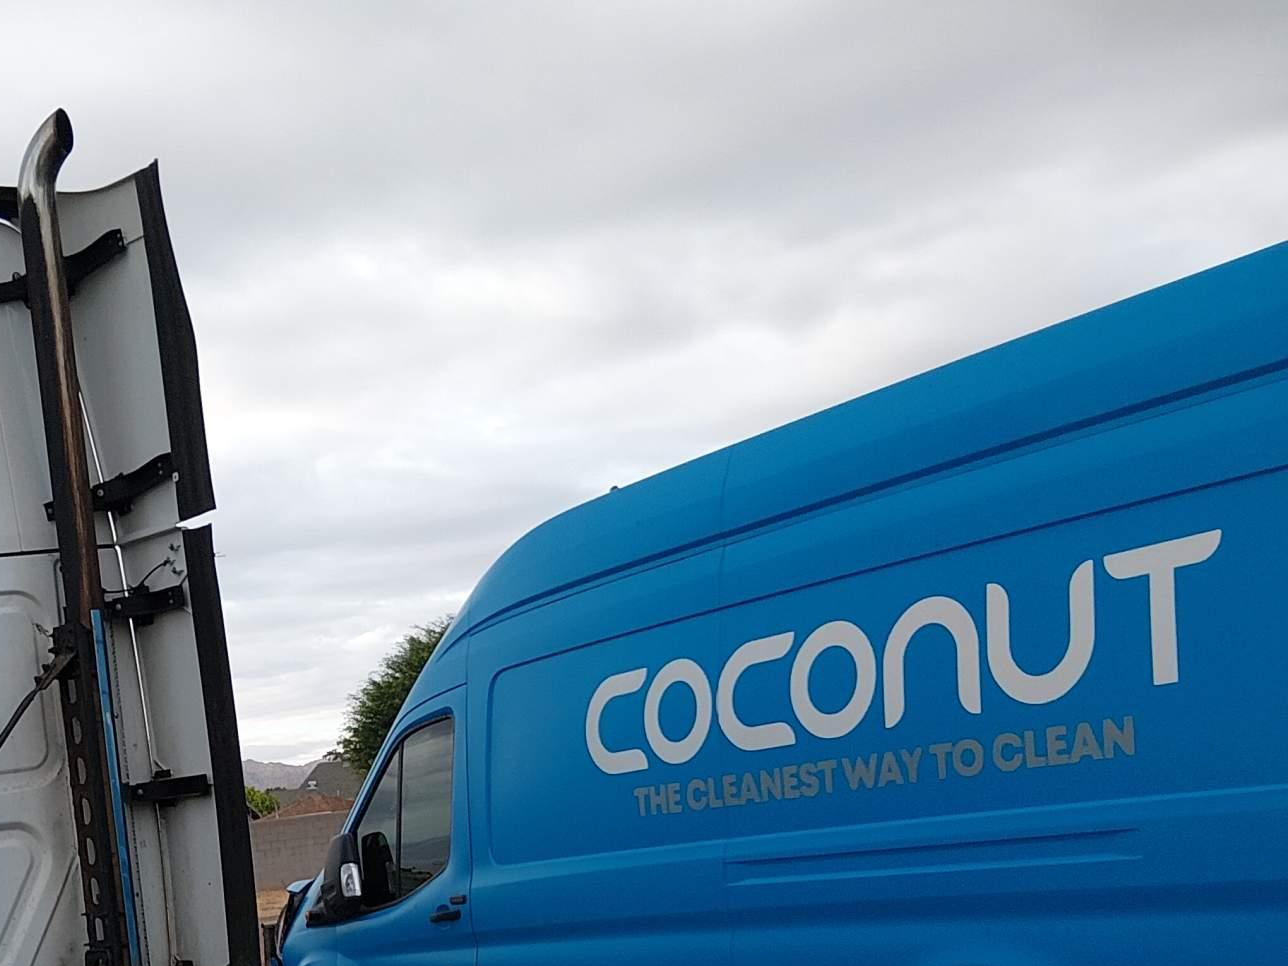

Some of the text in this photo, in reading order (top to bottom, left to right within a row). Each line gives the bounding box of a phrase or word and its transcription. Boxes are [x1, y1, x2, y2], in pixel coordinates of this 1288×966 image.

[634, 716, 1135, 816] THE CLEANEST WAY TO CLEAN
